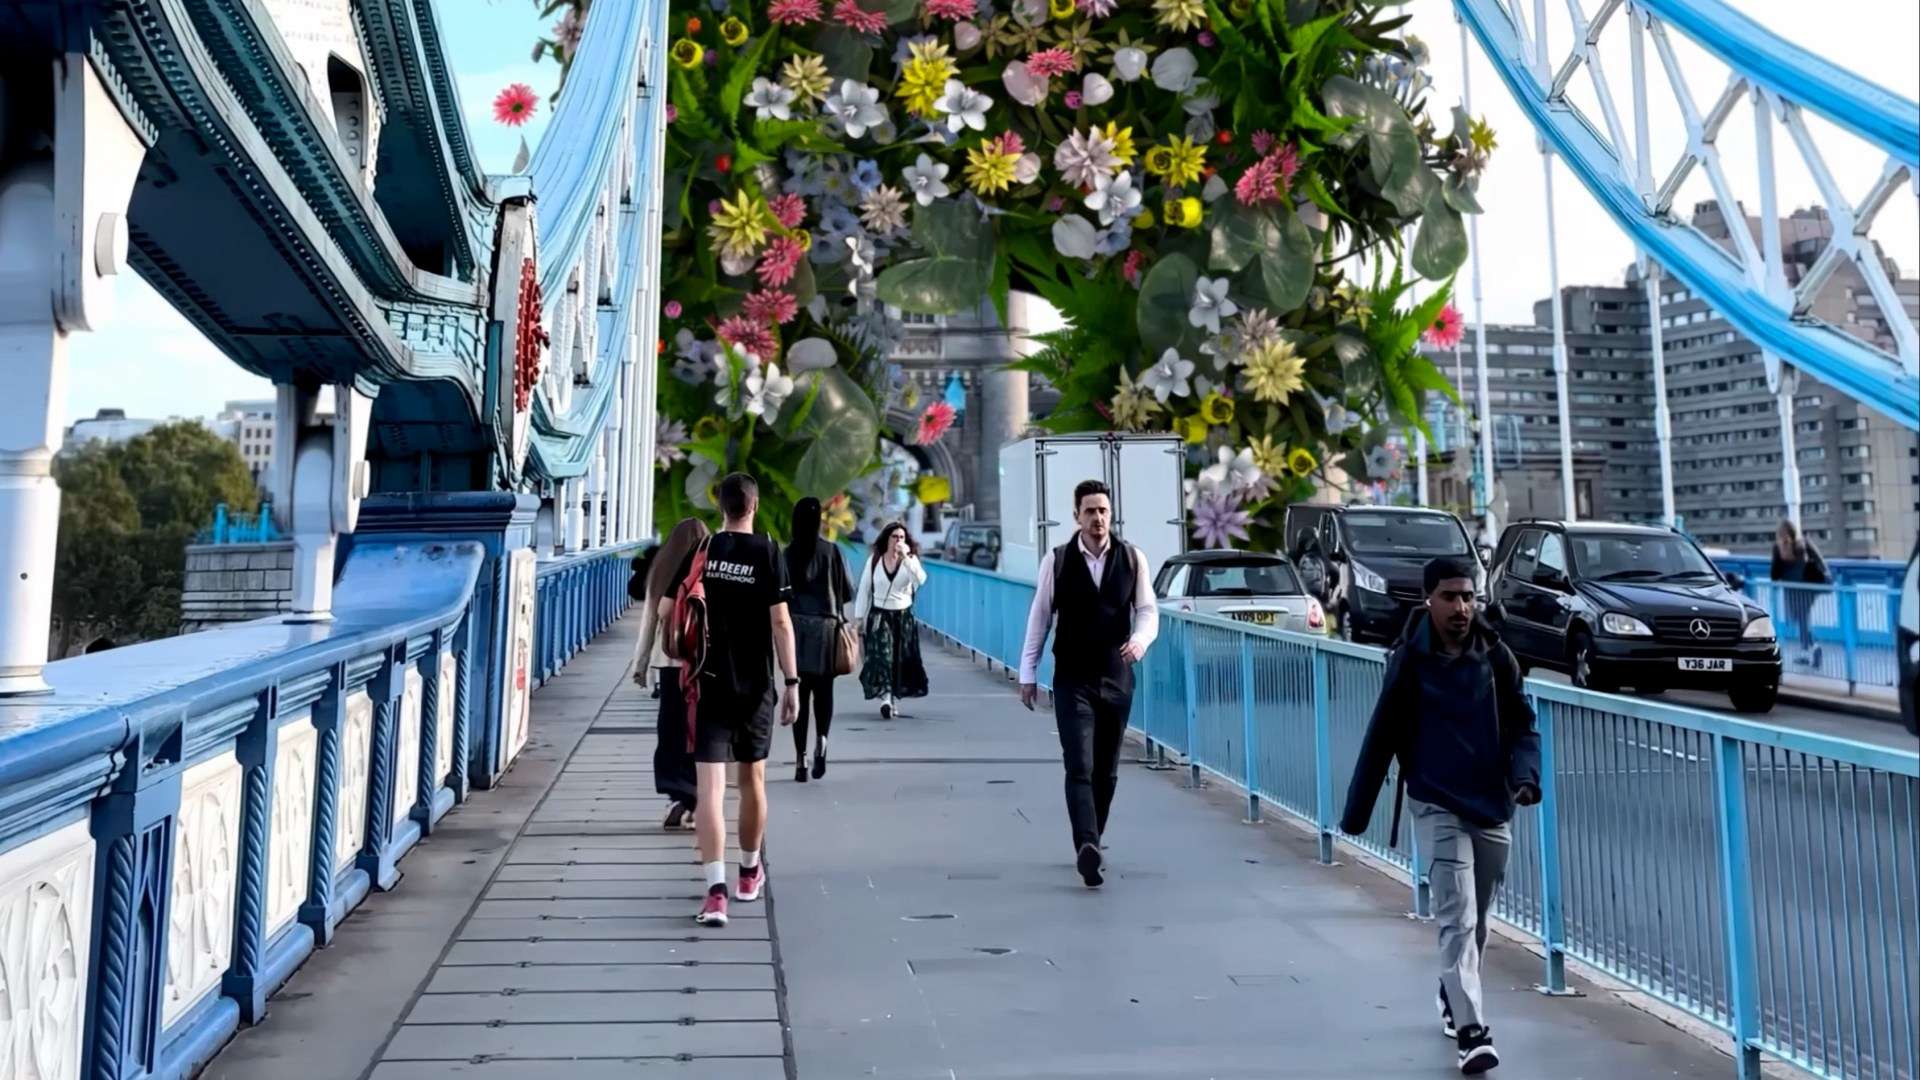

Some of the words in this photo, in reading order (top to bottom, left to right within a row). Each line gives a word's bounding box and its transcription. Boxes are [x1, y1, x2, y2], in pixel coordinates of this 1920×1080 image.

[705, 560, 718, 571] H
[719, 561, 754, 576] DEER!
[1685, 659, 1704, 669] Y36
[1706, 660, 1726, 670] JAR
